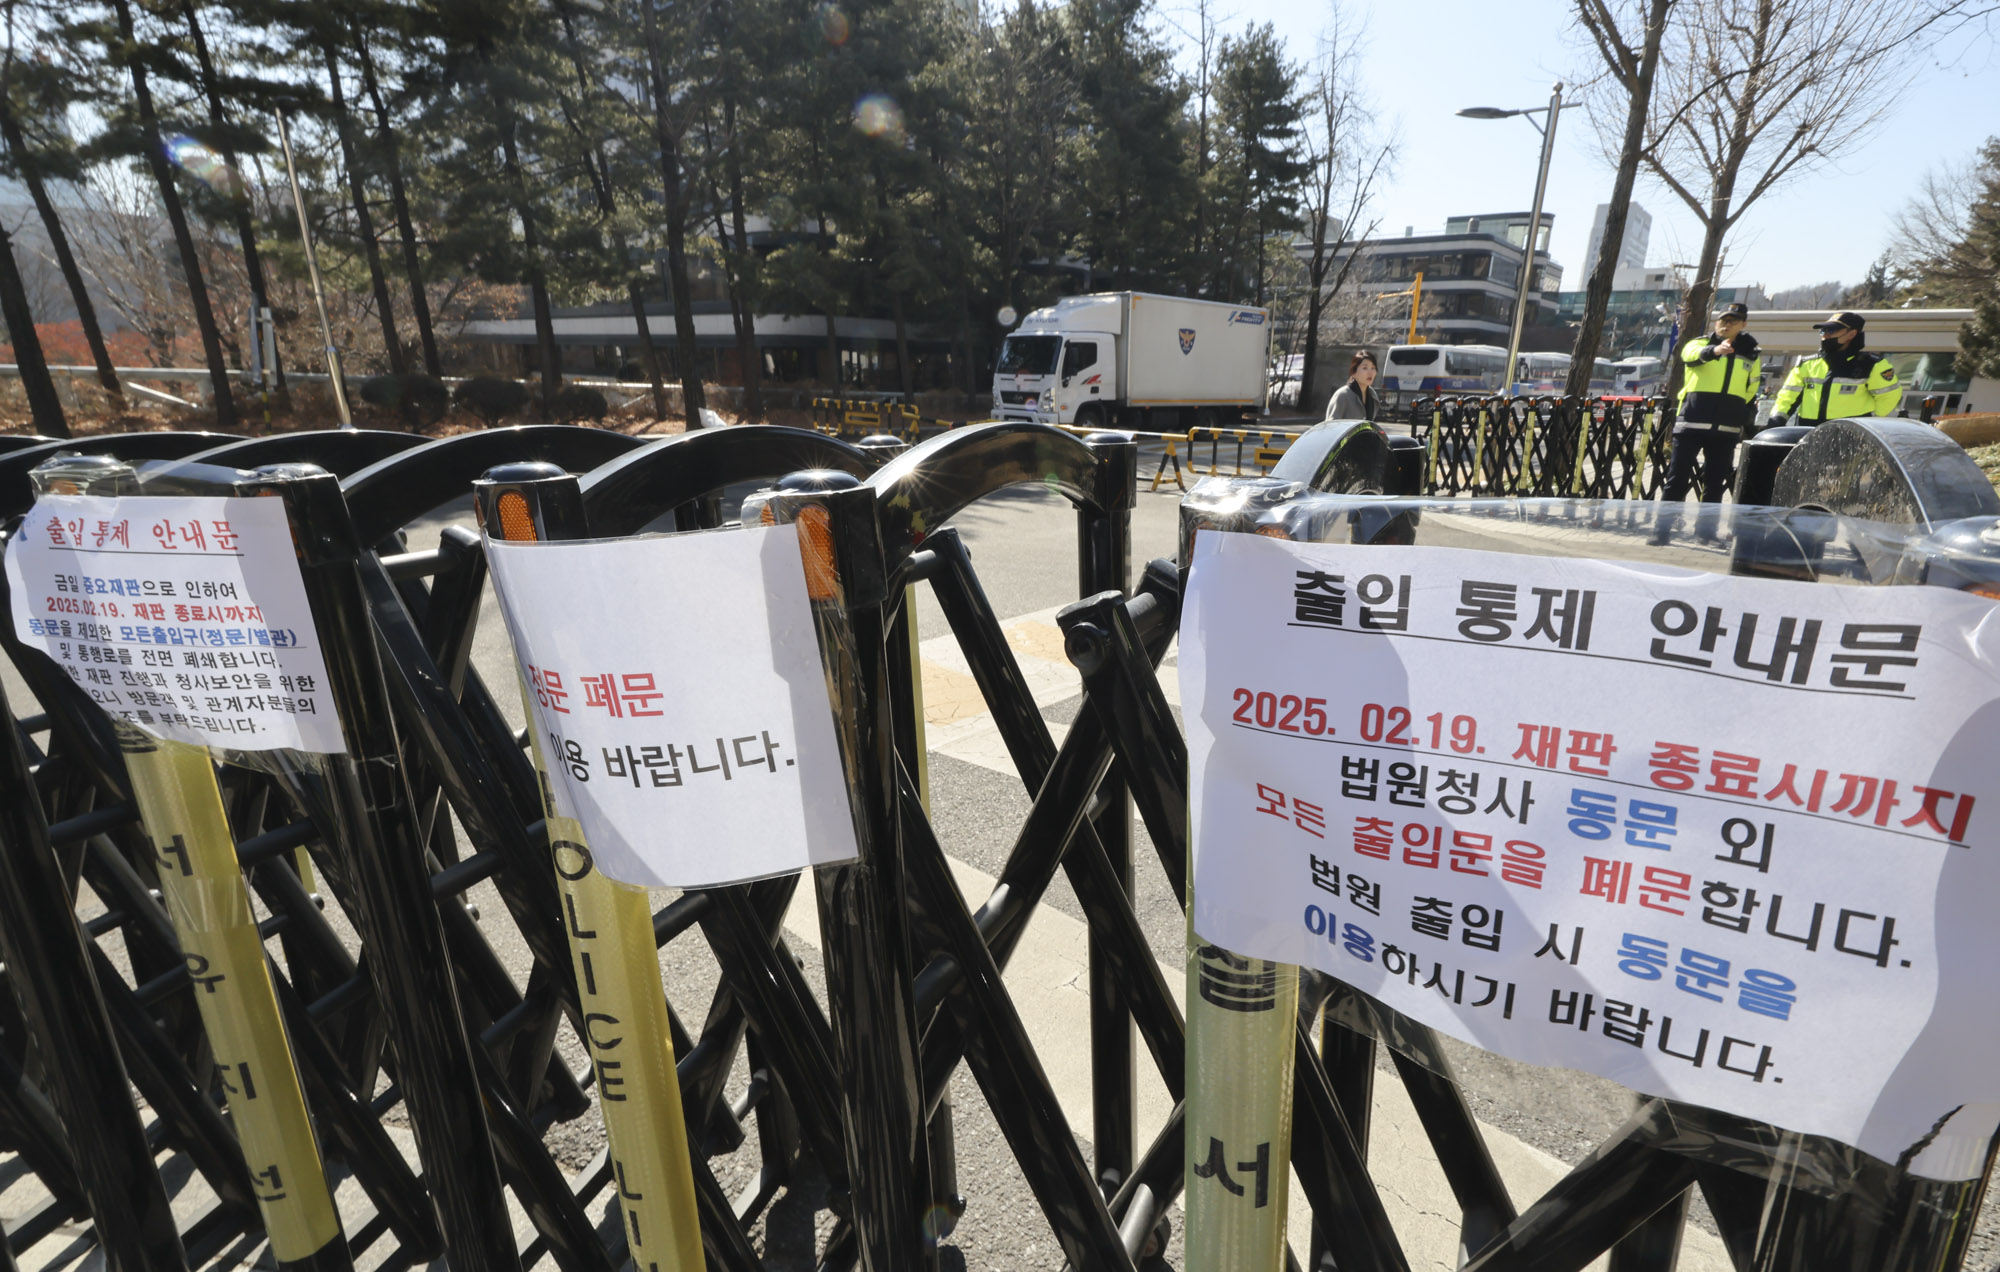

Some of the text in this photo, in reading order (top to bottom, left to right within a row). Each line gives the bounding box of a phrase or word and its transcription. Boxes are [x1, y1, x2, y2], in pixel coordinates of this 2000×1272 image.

[46, 517, 239, 551] 출입 통제 안내문
[47, 597, 263, 623] 2025.02.19. 재판 종료시까지
[55, 575, 238, 600] 금일 중요재판으로 인하여
[29, 618, 72, 636] 동문을
[78, 623, 112, 641] 제외한
[60, 642, 283, 669] 및 통행로를 전면 폐쇄합니다.
[1293, 571, 1922, 692] 출입 통제 안내문
[85, 668, 113, 686] 재판
[120, 671, 169, 689] 진행과
[176, 673, 273, 691] 청사보안을
[279, 674, 315, 693] 위한
[127, 691, 178, 708] 방문객
[182, 695, 195, 710] 및
[205, 694, 317, 715] 관계자분들의
[528, 663, 665, 718] 정문 폐문
[159, 710, 267, 734] 부탁드립니다.
[550, 730, 795, 788] 이용 바랍니다.
[1232, 687, 1976, 842] 2025. 02.19. 재판 종료시까지
[1340, 755, 1776, 873] 법원청사 동문 외
[1256, 783, 1913, 969] 모든 출입문을 폐문합니다.
[1309, 853, 1799, 1021] 법원 출입 시 동문을
[1303, 903, 1783, 1085] 이용하시기 바랍니다.
[616, 1160, 659, 1272] LI
